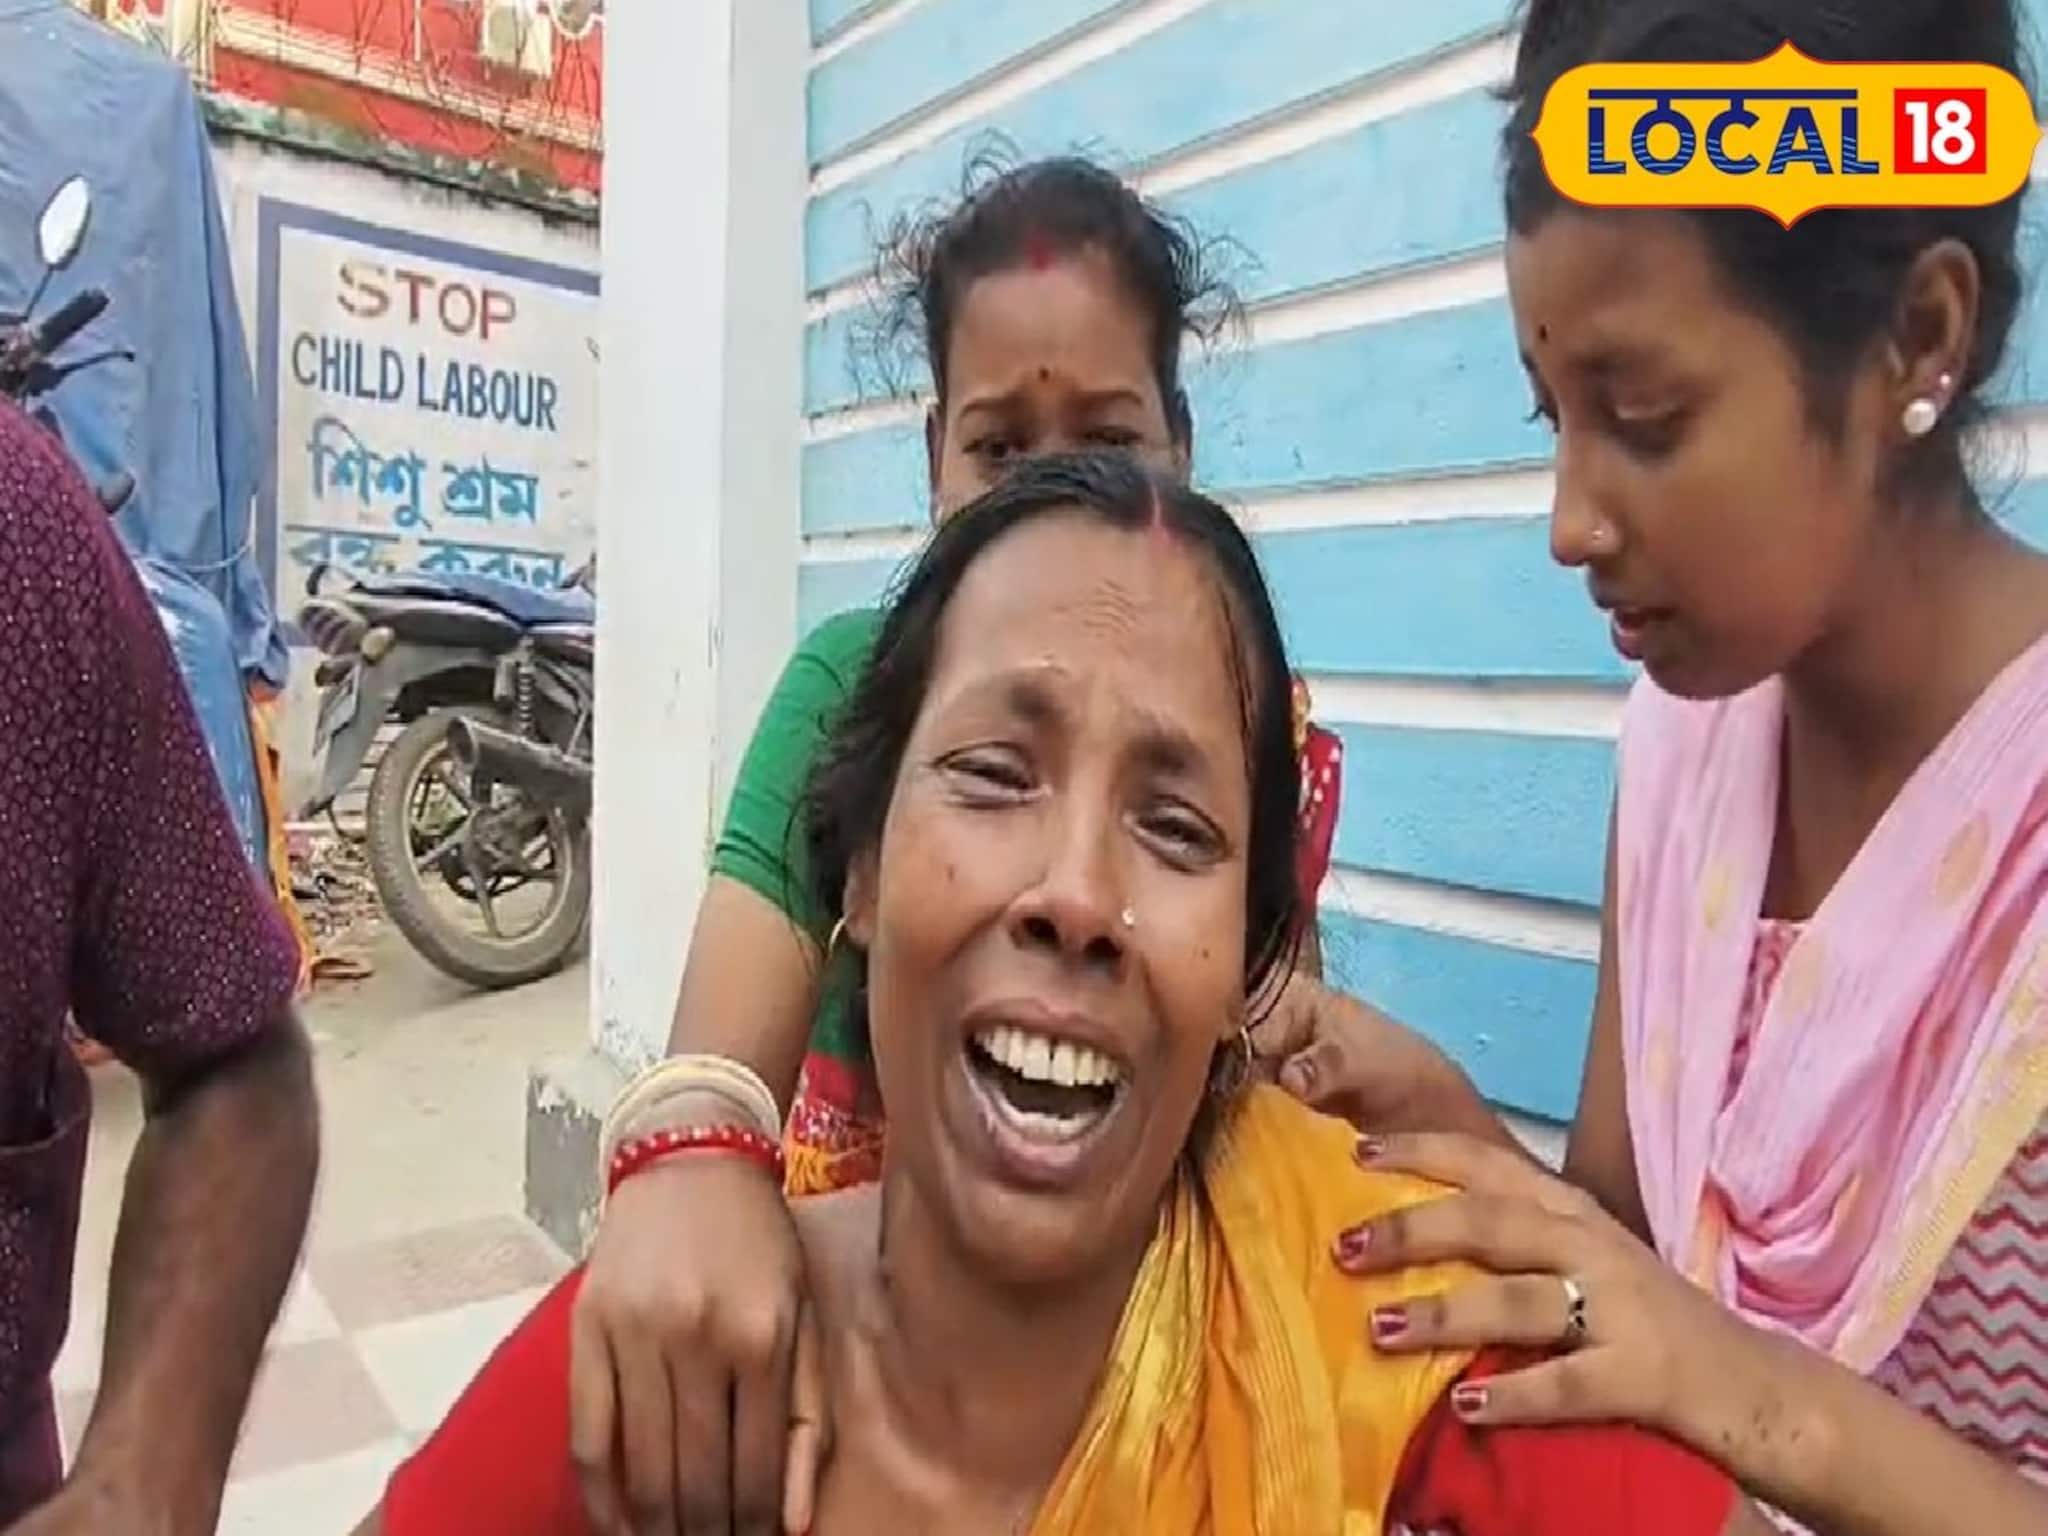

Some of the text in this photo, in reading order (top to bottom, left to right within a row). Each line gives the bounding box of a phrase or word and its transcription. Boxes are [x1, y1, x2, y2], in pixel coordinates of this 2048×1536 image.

[338, 257, 516, 339] STOP
[292, 331, 558, 432] CHILD LABOUR
[305, 415, 539, 531] শিশু শ্রম
